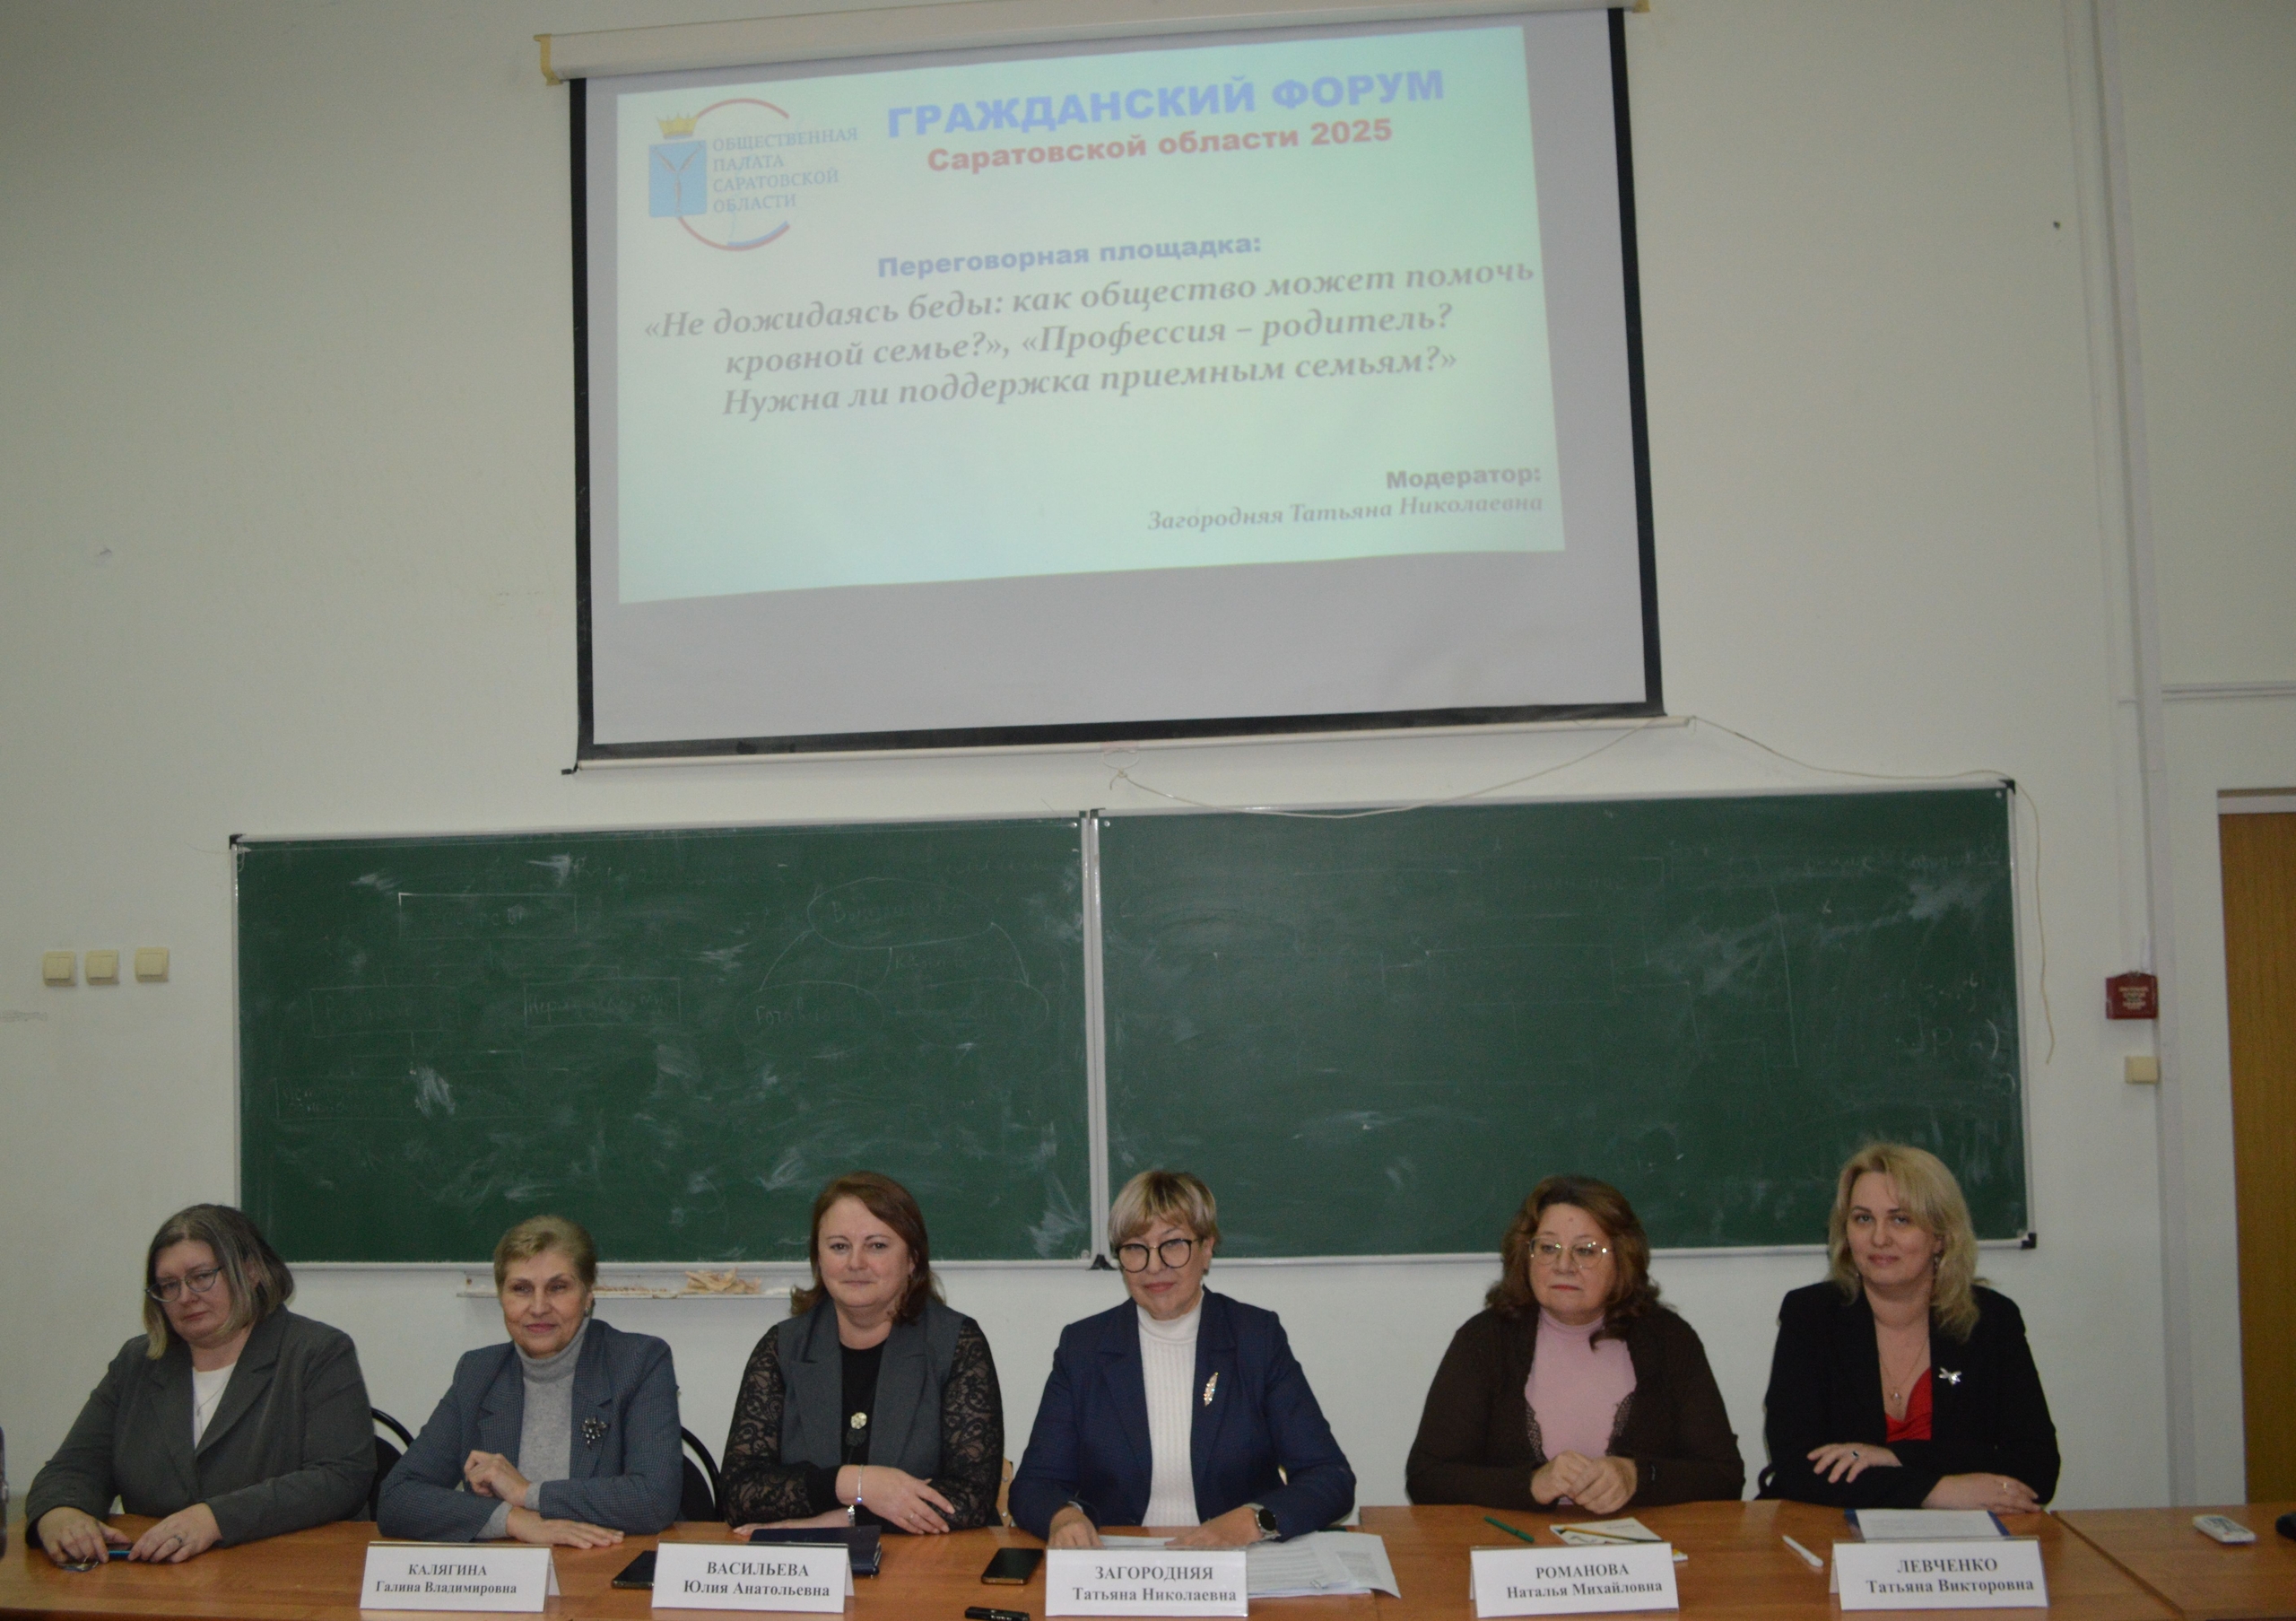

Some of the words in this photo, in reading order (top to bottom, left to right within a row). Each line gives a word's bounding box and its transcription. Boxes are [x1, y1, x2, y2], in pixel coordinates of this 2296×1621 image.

[888, 76, 1255, 137] ГРАЖДАНСКИЙ
[1272, 69, 1445, 109] ФОРУМ
[713, 126, 858, 152] ОБЩЕСТВЕННАЯ
[927, 135, 1147, 174] Саратовской
[1158, 126, 1299, 155] области
[1310, 118, 1393, 146] 2025
[713, 154, 784, 172] ПАЛАТА
[713, 167, 839, 193] САРАТОВСКОЙ
[713, 194, 796, 213] ОБЛАСТИ
[878, 247, 1090, 279] Переговорная
[1100, 236, 1261, 263] площадка:
[644, 311, 705, 338] «Не
[714, 301, 899, 334] дожидаясь
[909, 290, 1004, 321] беды:
[1013, 290, 1073, 313] как
[1082, 280, 1256, 312] общество
[1265, 271, 1395, 297] может
[1405, 262, 1535, 290] помочь
[726, 341, 865, 380] кровной
[874, 330, 1011, 364] семье?»,
[1022, 320, 1227, 358] «Профессия
[1261, 302, 1454, 347] родитель?
[722, 387, 839, 422] Нужна
[848, 385, 889, 408] ли
[899, 371, 1090, 405] поддержка
[1100, 361, 1285, 397] приемным
[1295, 345, 1457, 379] семьям?»
[1387, 466, 1541, 490] Модератор:
[1147, 506, 1283, 532] Загородняя
[1290, 501, 1393, 523] Татьяна
[1399, 495, 1543, 517] Николаевна
[408, 1564, 487, 1576] КАЛЯГИНА
[707, 1561, 809, 1576] ВАСИЛЬЕВА
[1095, 1566, 1213, 1581] ЗАГОРОДНЯЯ
[1535, 1563, 1630, 1579] РОМАНОВА
[1897, 1557, 1998, 1573] ЛЕВЧЕНКО
[376, 1581, 422, 1593] Галина
[424, 1581, 517, 1596] Владимировна
[683, 1580, 728, 1595] Юлия
[733, 1582, 830, 1597] Анатольевна
[1073, 1587, 1137, 1601] Татьяна
[1143, 1588, 1237, 1602] Николаевна
[1507, 1584, 1568, 1599] Наталья
[1572, 1582, 1663, 1596] Михайловна
[1866, 1579, 1932, 1594] Татьяна
[1938, 1578, 2034, 1594] Викторовна
